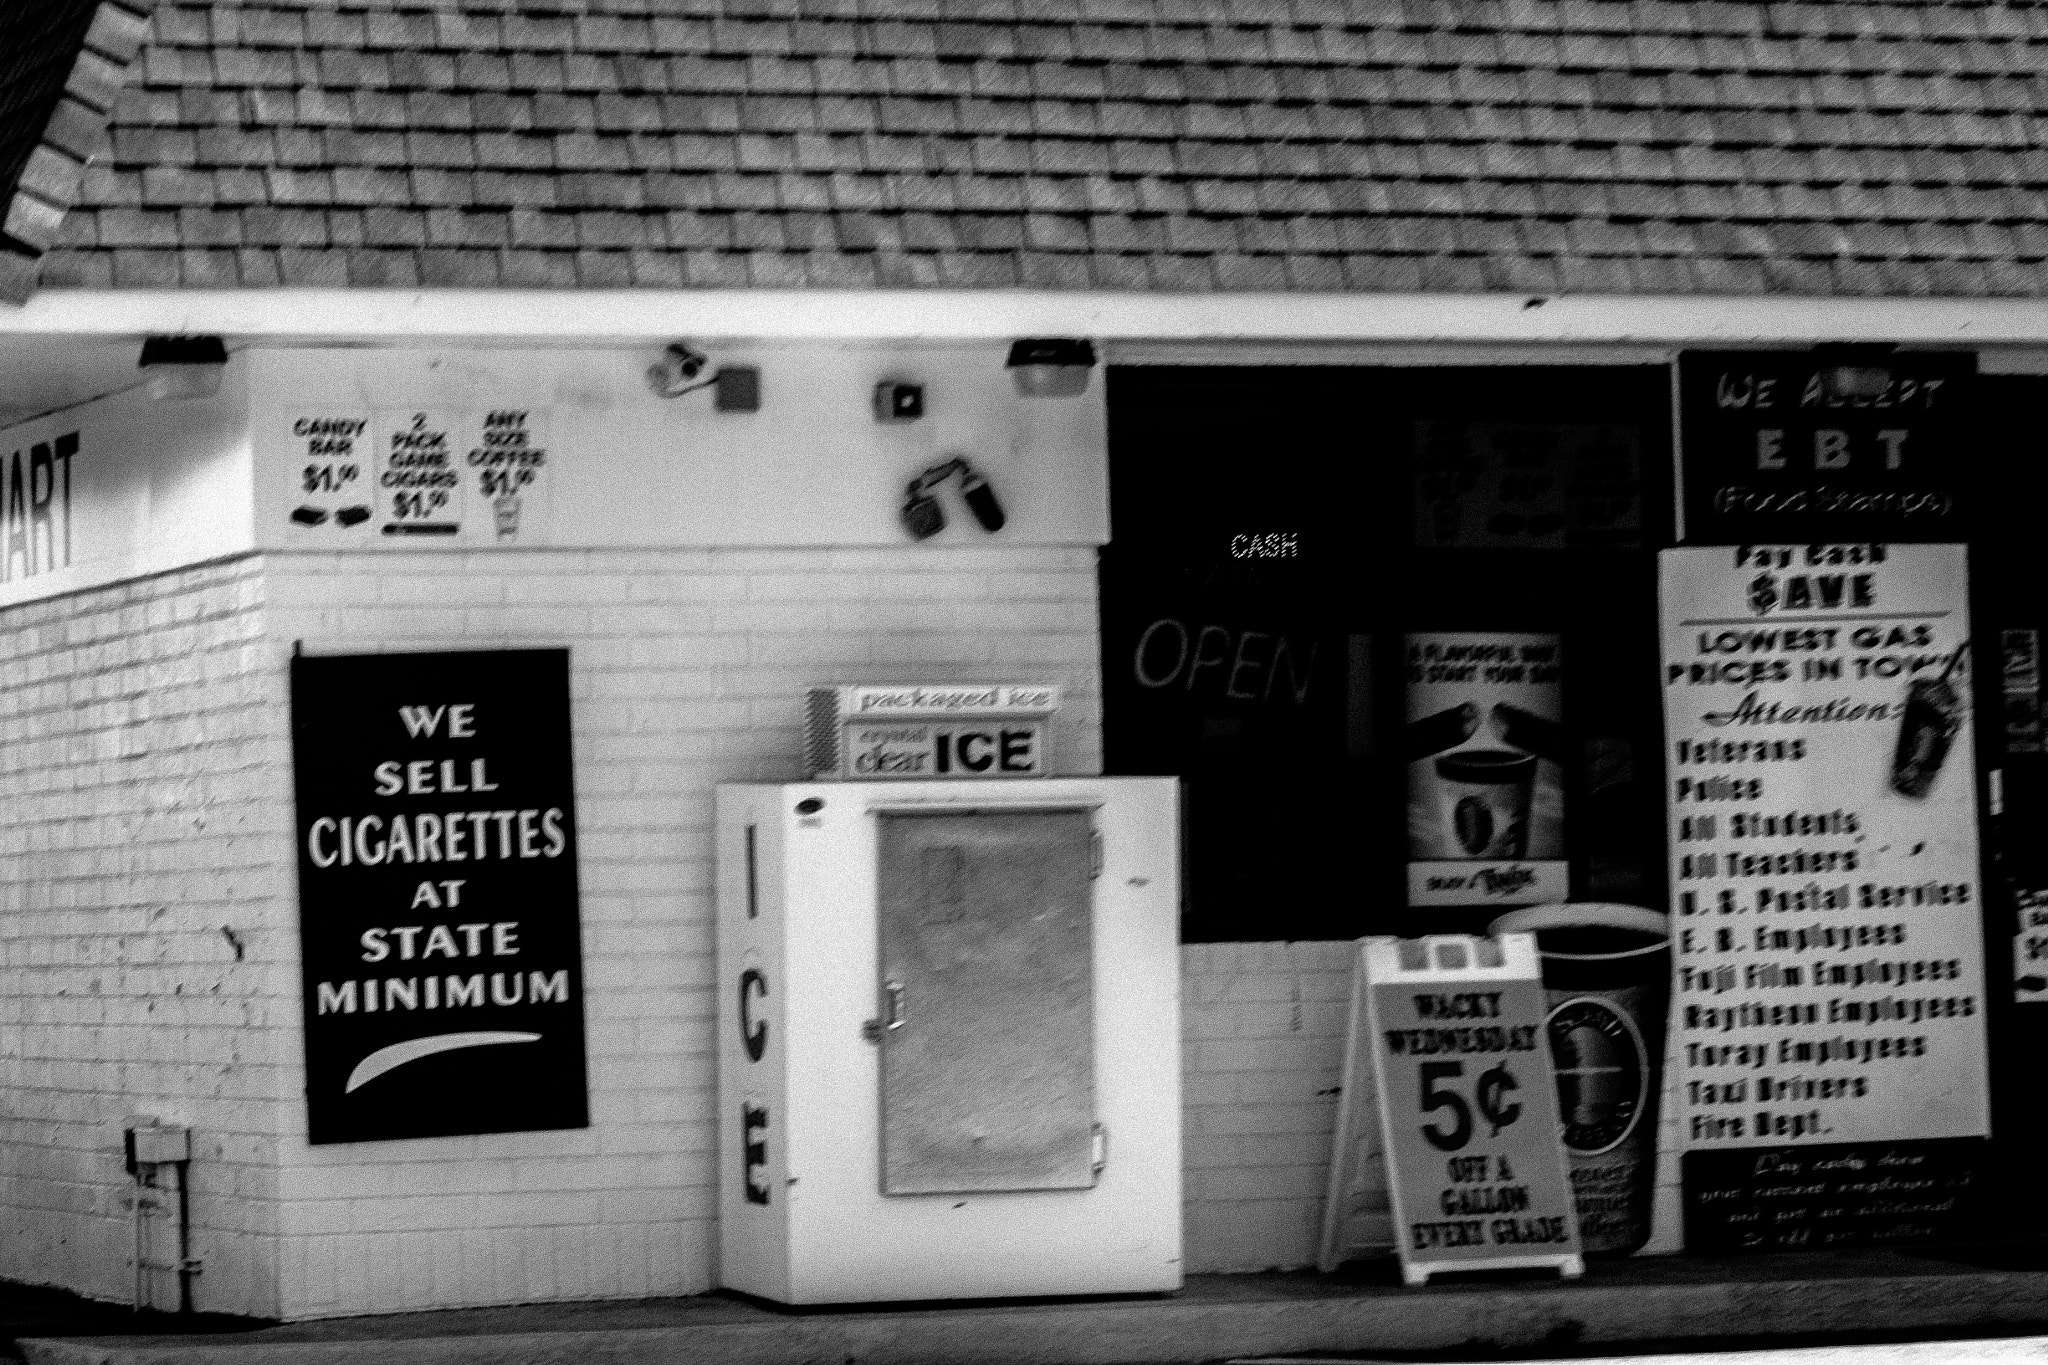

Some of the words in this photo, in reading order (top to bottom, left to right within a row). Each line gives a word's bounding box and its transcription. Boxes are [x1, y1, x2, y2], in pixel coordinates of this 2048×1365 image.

[1716, 371, 1777, 409] WE
[293, 418, 368, 438] CANDY
[411, 412, 427, 431] 2
[308, 438, 353, 456] BAR
[391, 432, 447, 449] PACK
[467, 448, 547, 467] COFFEE
[381, 470, 459, 489] CIGARS
[0, 431, 79, 584] ART
[1231, 532, 1298, 559] CASH
[1698, 627, 1840, 655] LOWEST
[1851, 624, 1934, 650] GAS
[1133, 617, 1321, 706] OPEN
[1667, 659, 1792, 686] PRICES
[1802, 657, 1842, 682] IN
[397, 703, 477, 739] WE
[855, 742, 931, 773] clear
[935, 729, 1034, 773] ICE
[1676, 737, 1808, 764] Veterans
[373, 757, 500, 797] SELL
[308, 806, 567, 868] CIGARETTES
[1729, 809, 1860, 840] Students
[1726, 848, 1860, 878] Teachers
[410, 878, 467, 910] AT
[1755, 882, 1851, 914] Postal
[1857, 881, 1971, 909] Service
[360, 921, 521, 963] STATE
[1755, 922, 1906, 953] Employees
[1813, 957, 1961, 988] Employees
[316, 969, 570, 1016] MINIMUM
[1412, 991, 1503, 1020] WACKY
[1684, 1002, 1820, 1032] Raytheon
[1828, 995, 1976, 1025] Employees
[1383, 1023, 1539, 1056] WEDNESDAY
[1778, 1034, 1928, 1065] Employees
[1756, 1074, 1868, 1103] Drivers
[1419, 1059, 1522, 1152] 5¢
[1447, 1155, 1489, 1184] OFF
[1494, 1155, 1516, 1182] A
[1440, 1185, 1532, 1217] GALLON
[1411, 1219, 1487, 1251] EVERY
[1490, 1215, 1570, 1246] GRADE
